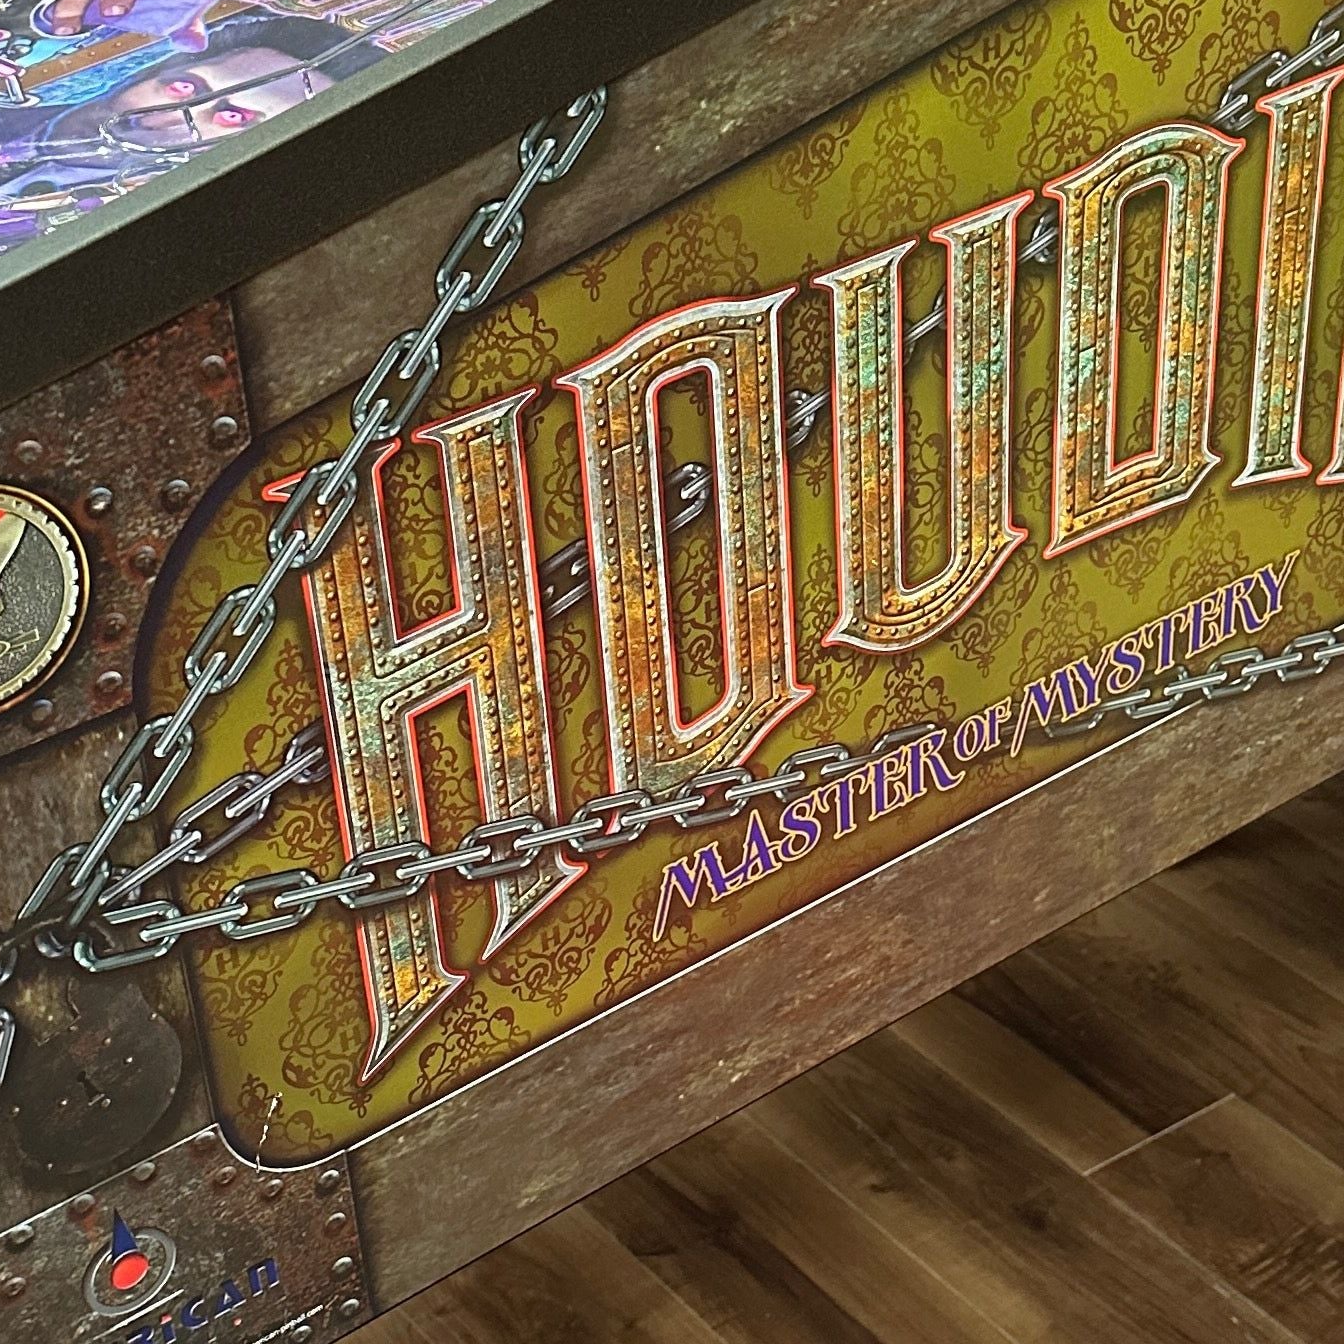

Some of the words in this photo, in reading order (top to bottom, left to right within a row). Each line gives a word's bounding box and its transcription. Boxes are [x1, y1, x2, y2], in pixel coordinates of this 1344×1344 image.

[651, 728, 966, 942] MASTER
[952, 699, 1011, 759] OF
[1008, 549, 1301, 757] MYSTERY
